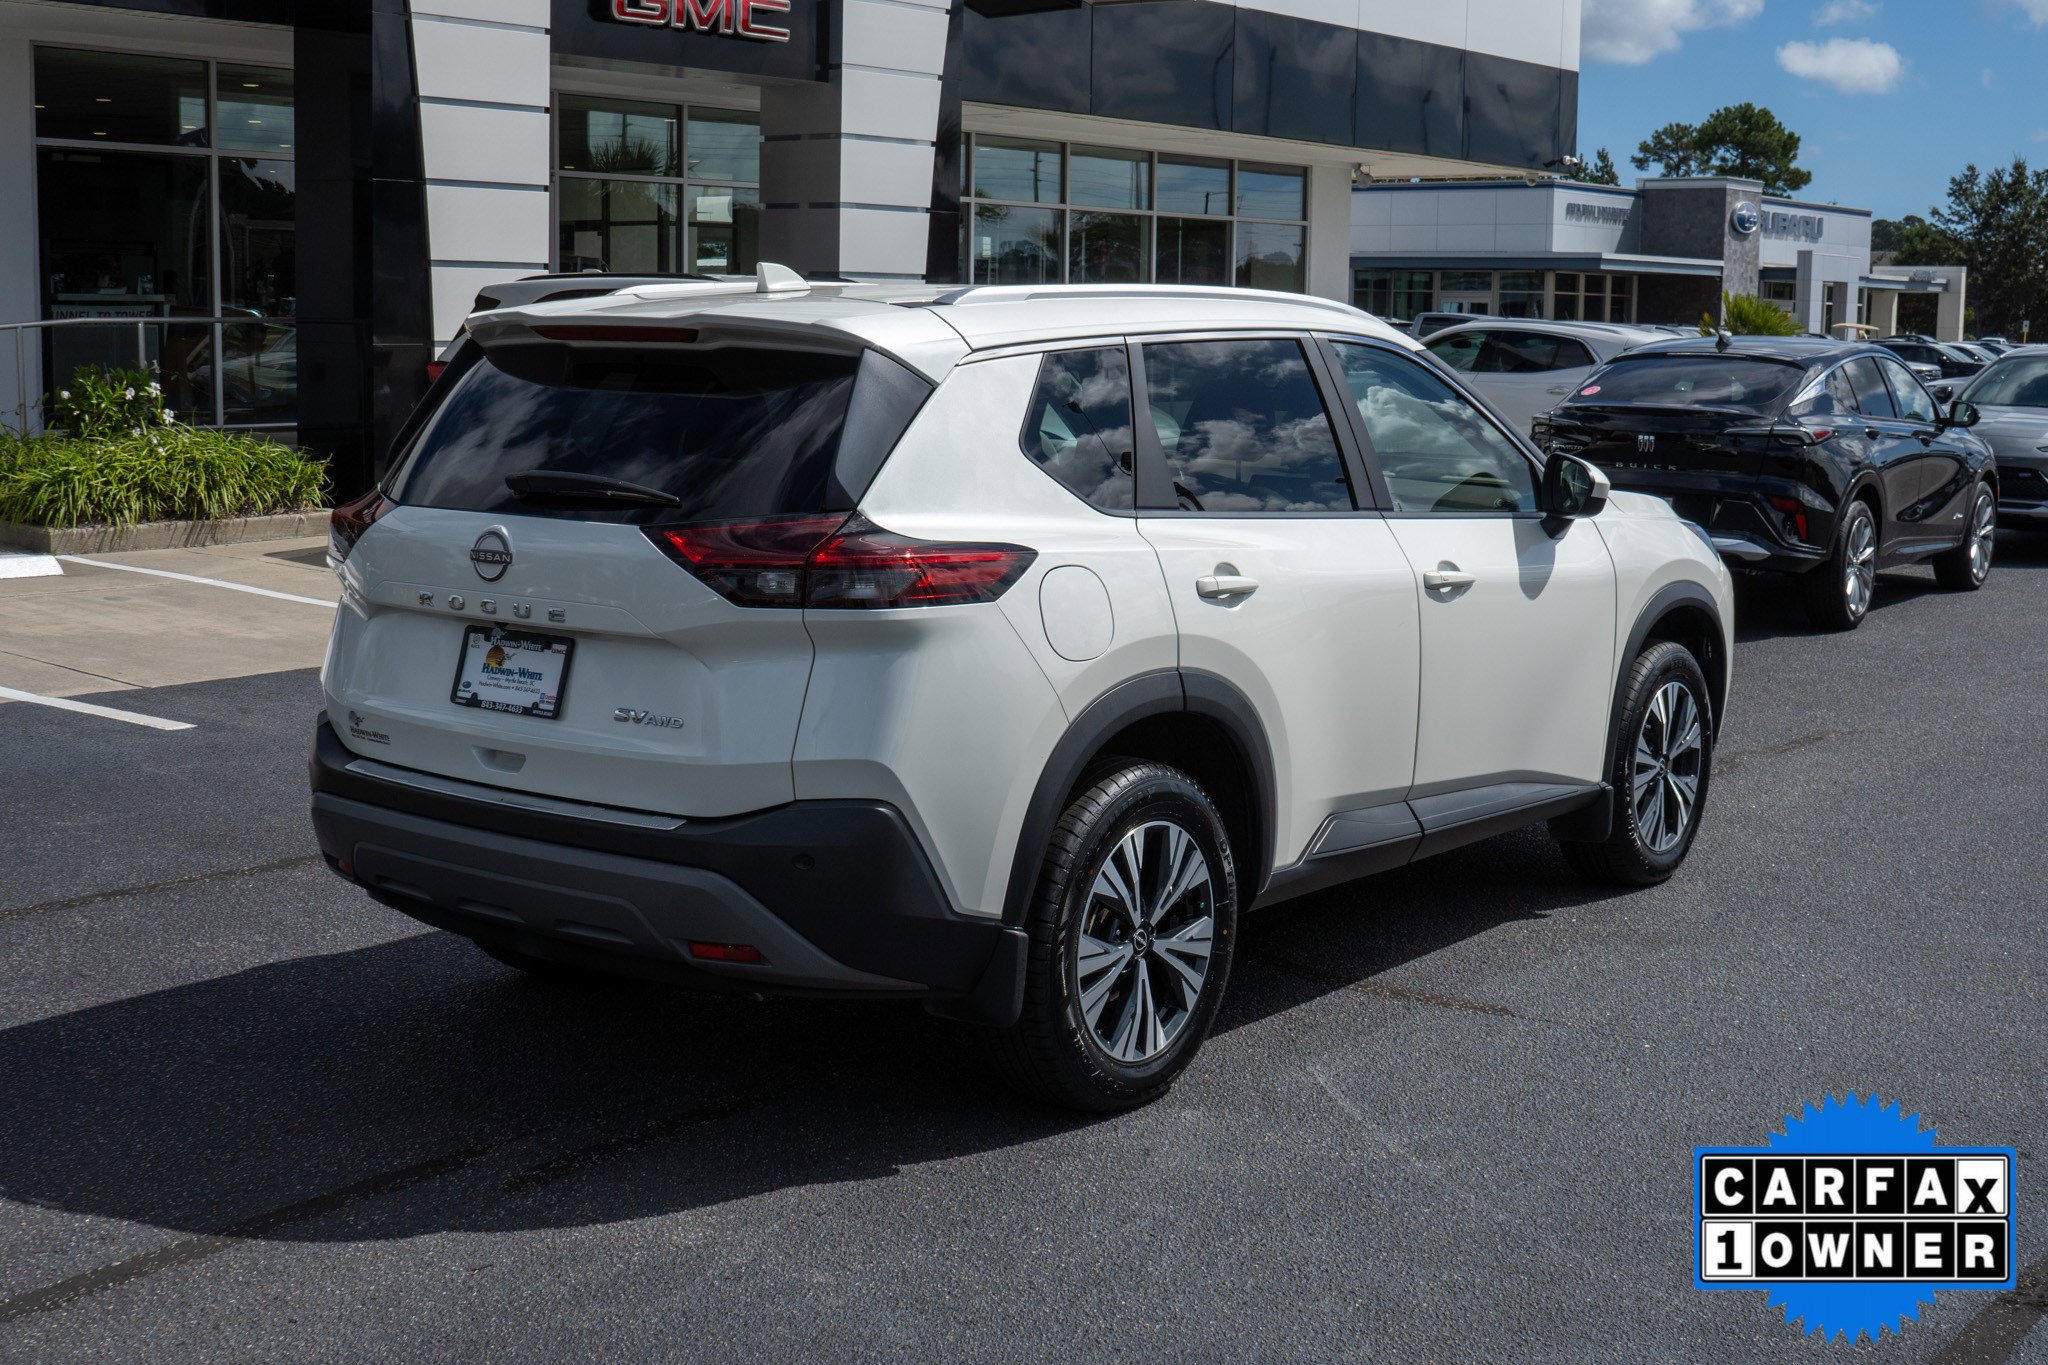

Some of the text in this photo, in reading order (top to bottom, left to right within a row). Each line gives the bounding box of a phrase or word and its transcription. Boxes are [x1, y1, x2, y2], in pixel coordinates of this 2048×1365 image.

[612, 0, 791, 43] GMC
[1615, 462, 1677, 471] BUICK
[471, 550, 511, 563] NISSAN
[419, 590, 567, 623] ROGUE
[481, 700, 523, 714] 843-347-4633
